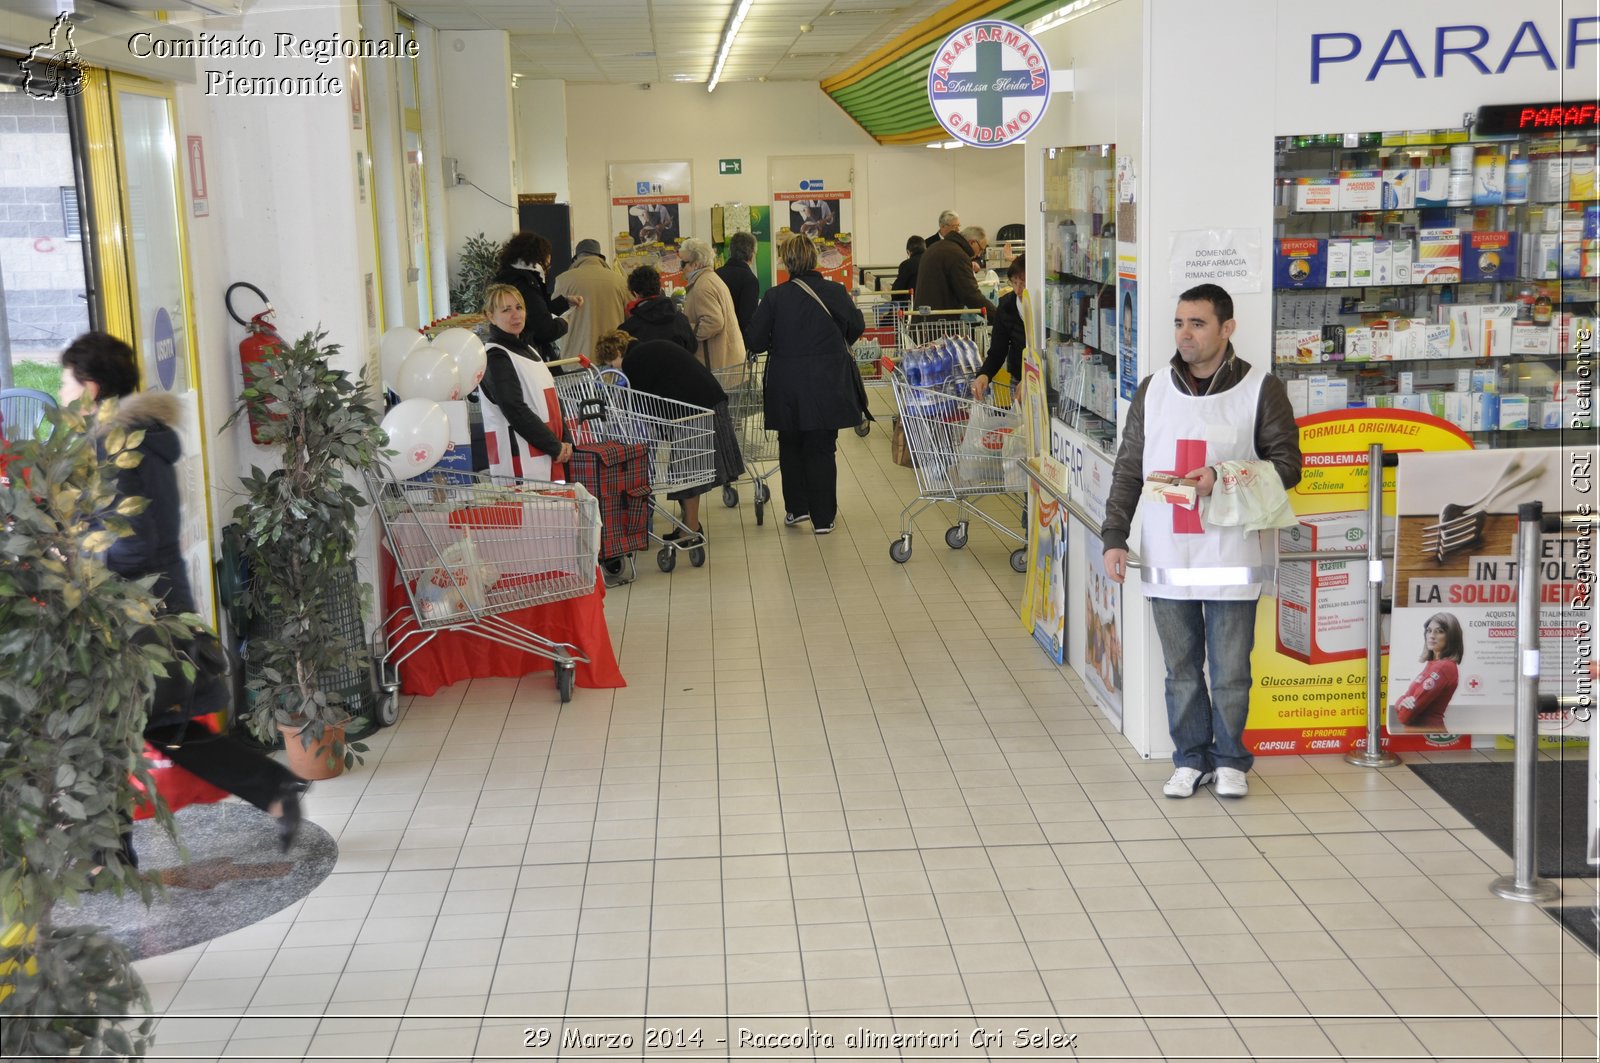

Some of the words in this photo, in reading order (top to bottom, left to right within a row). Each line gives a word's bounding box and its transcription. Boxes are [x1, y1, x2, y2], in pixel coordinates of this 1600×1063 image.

[934, 27, 1045, 92] PARAFARMACIA
[948, 80, 988, 93] Dott.ssa
[949, 111, 1031, 141] GAIDANO
[1195, 249, 1237, 257] DOMENICA
[1186, 258, 1246, 268] PARAFARMACIA
[1185, 271, 1215, 279] RIMANE
[1217, 270, 1247, 278] CHIUSO
[1303, 423, 1355, 440] FORMULA
[1358, 422, 1420, 436] ORIGINALE!
[1305, 454, 1354, 465] PROBLEMI
[1303, 469, 1324, 478] Collo
[1312, 481, 1344, 490] Schiena
[1347, 530, 1361, 541] ESI
[1319, 562, 1346, 570] CAPSULE
[1476, 562, 1497, 581] IN
[1416, 584, 1443, 603] LA
[1489, 629, 1516, 637] DONARE
[1260, 674, 1333, 687] Glucosamina
[1272, 694, 1299, 702] sono
[1302, 691, 1367, 702] component
[1278, 708, 1337, 719] cartilagine
[1314, 729, 1347, 737] PROPONE
[1259, 741, 1296, 750] CAPSULE
[1311, 740, 1341, 749] CREMA
